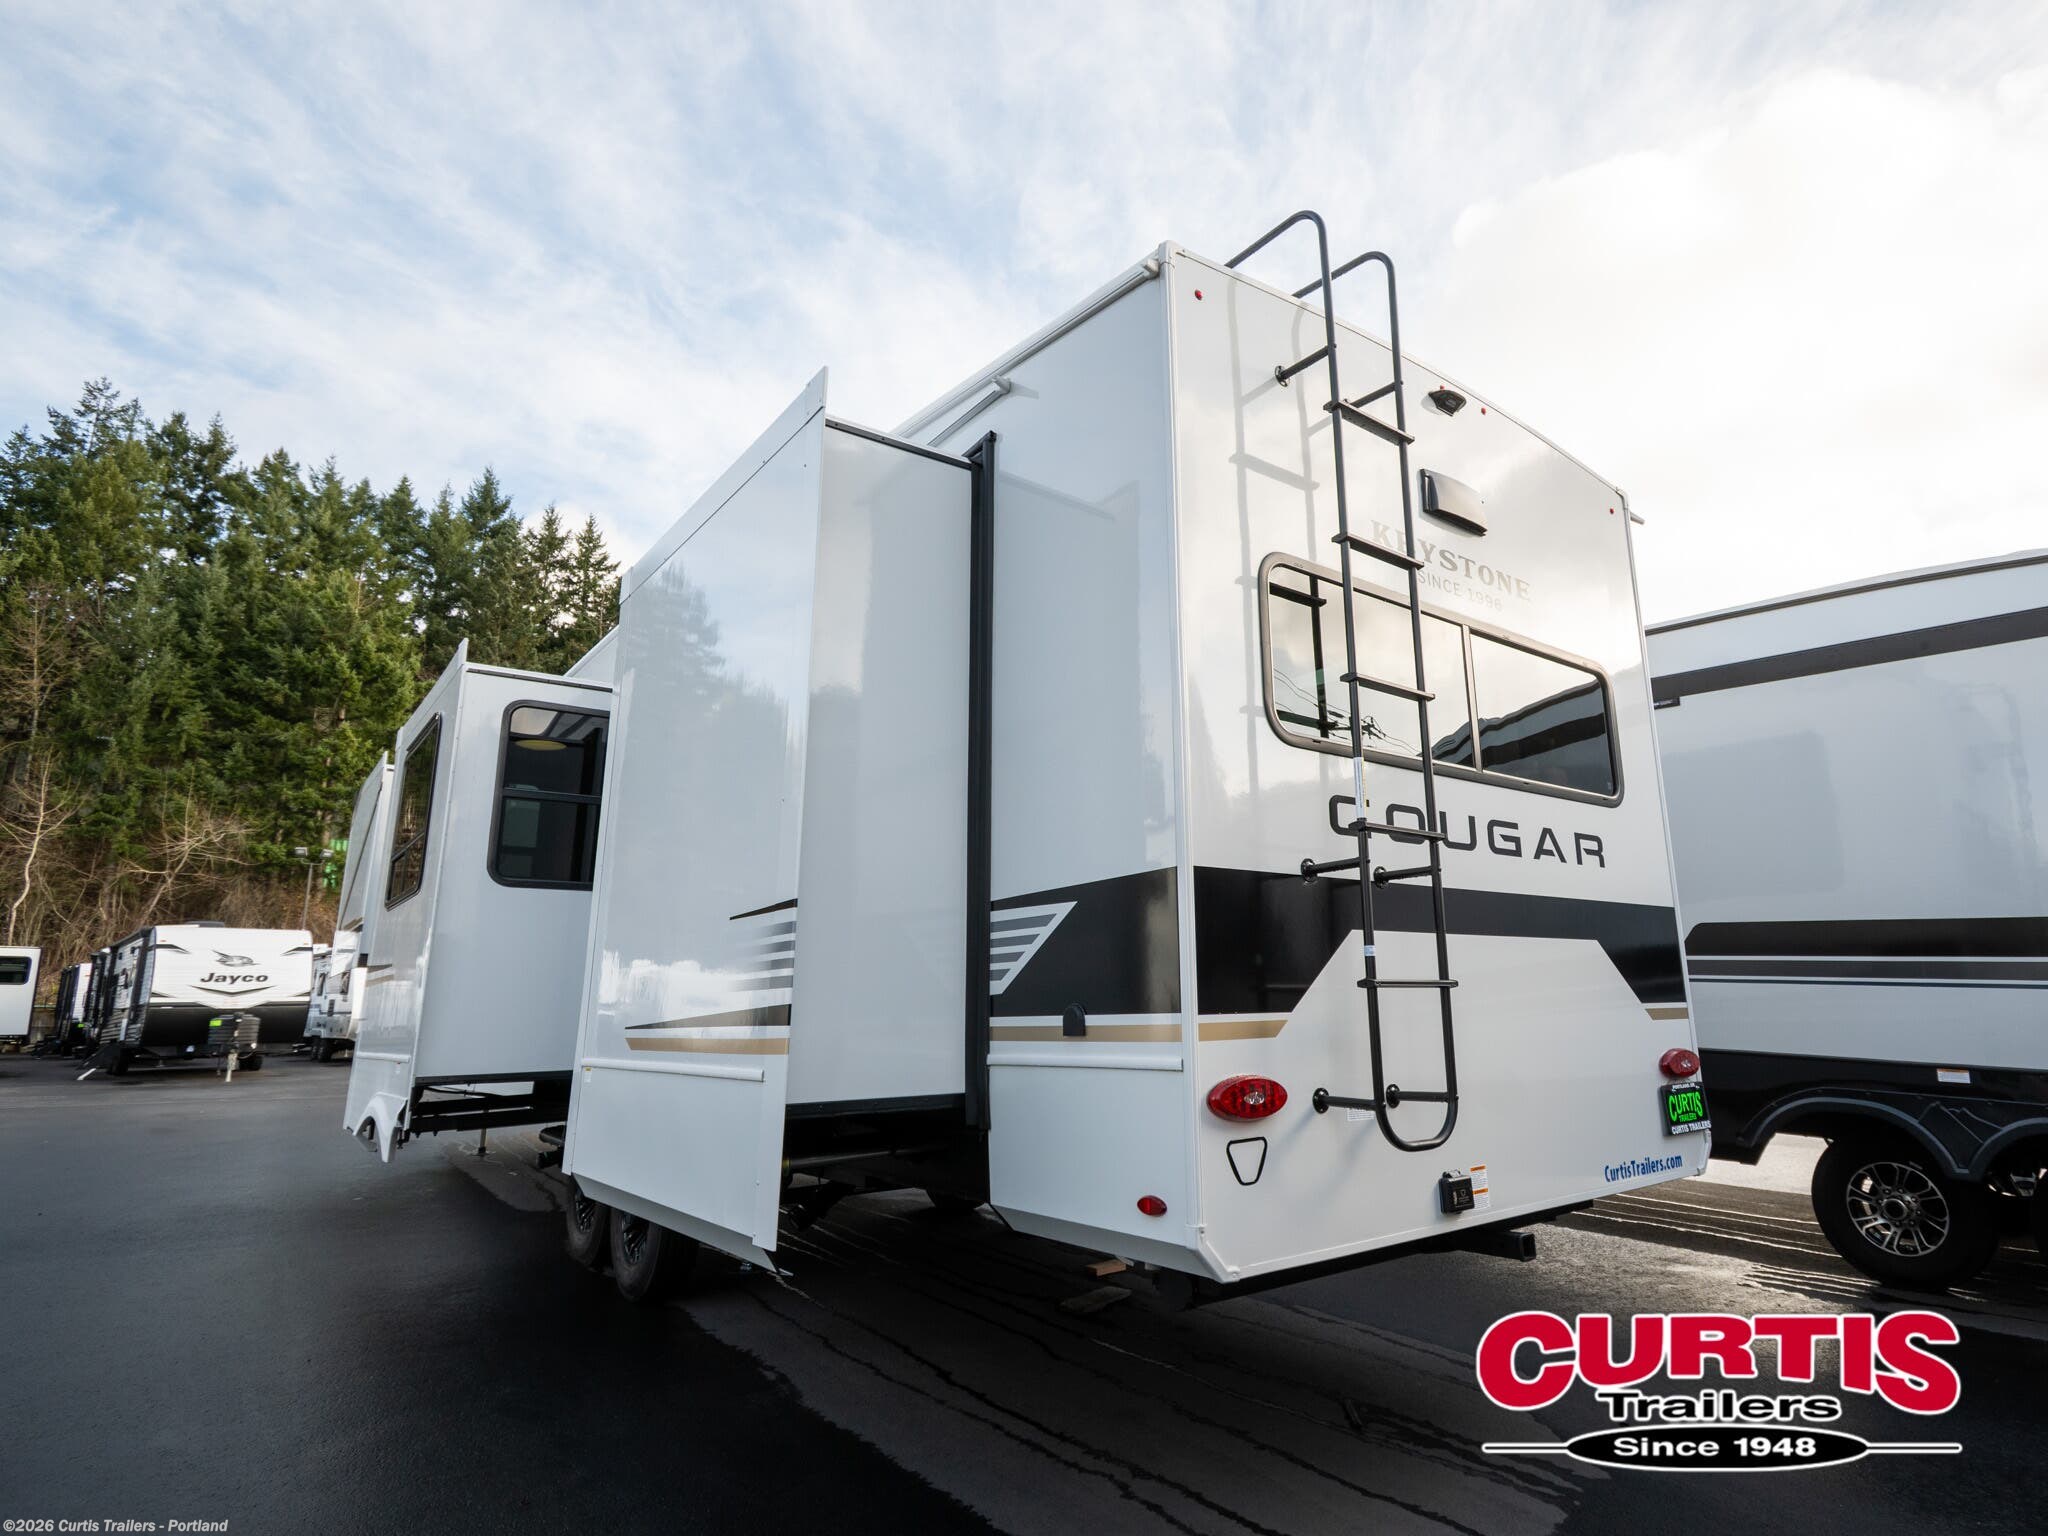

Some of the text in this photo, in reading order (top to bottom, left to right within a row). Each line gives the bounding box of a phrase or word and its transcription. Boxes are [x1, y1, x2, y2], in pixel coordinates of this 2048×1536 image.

[1417, 570, 1463, 597] SINCE
[1329, 794, 1606, 868] COUGAR
[200, 972, 269, 985] Jayco
[1669, 1091, 1703, 1122] CURTIS
[1604, 1155, 1683, 1182] CurtisTrailers.com
